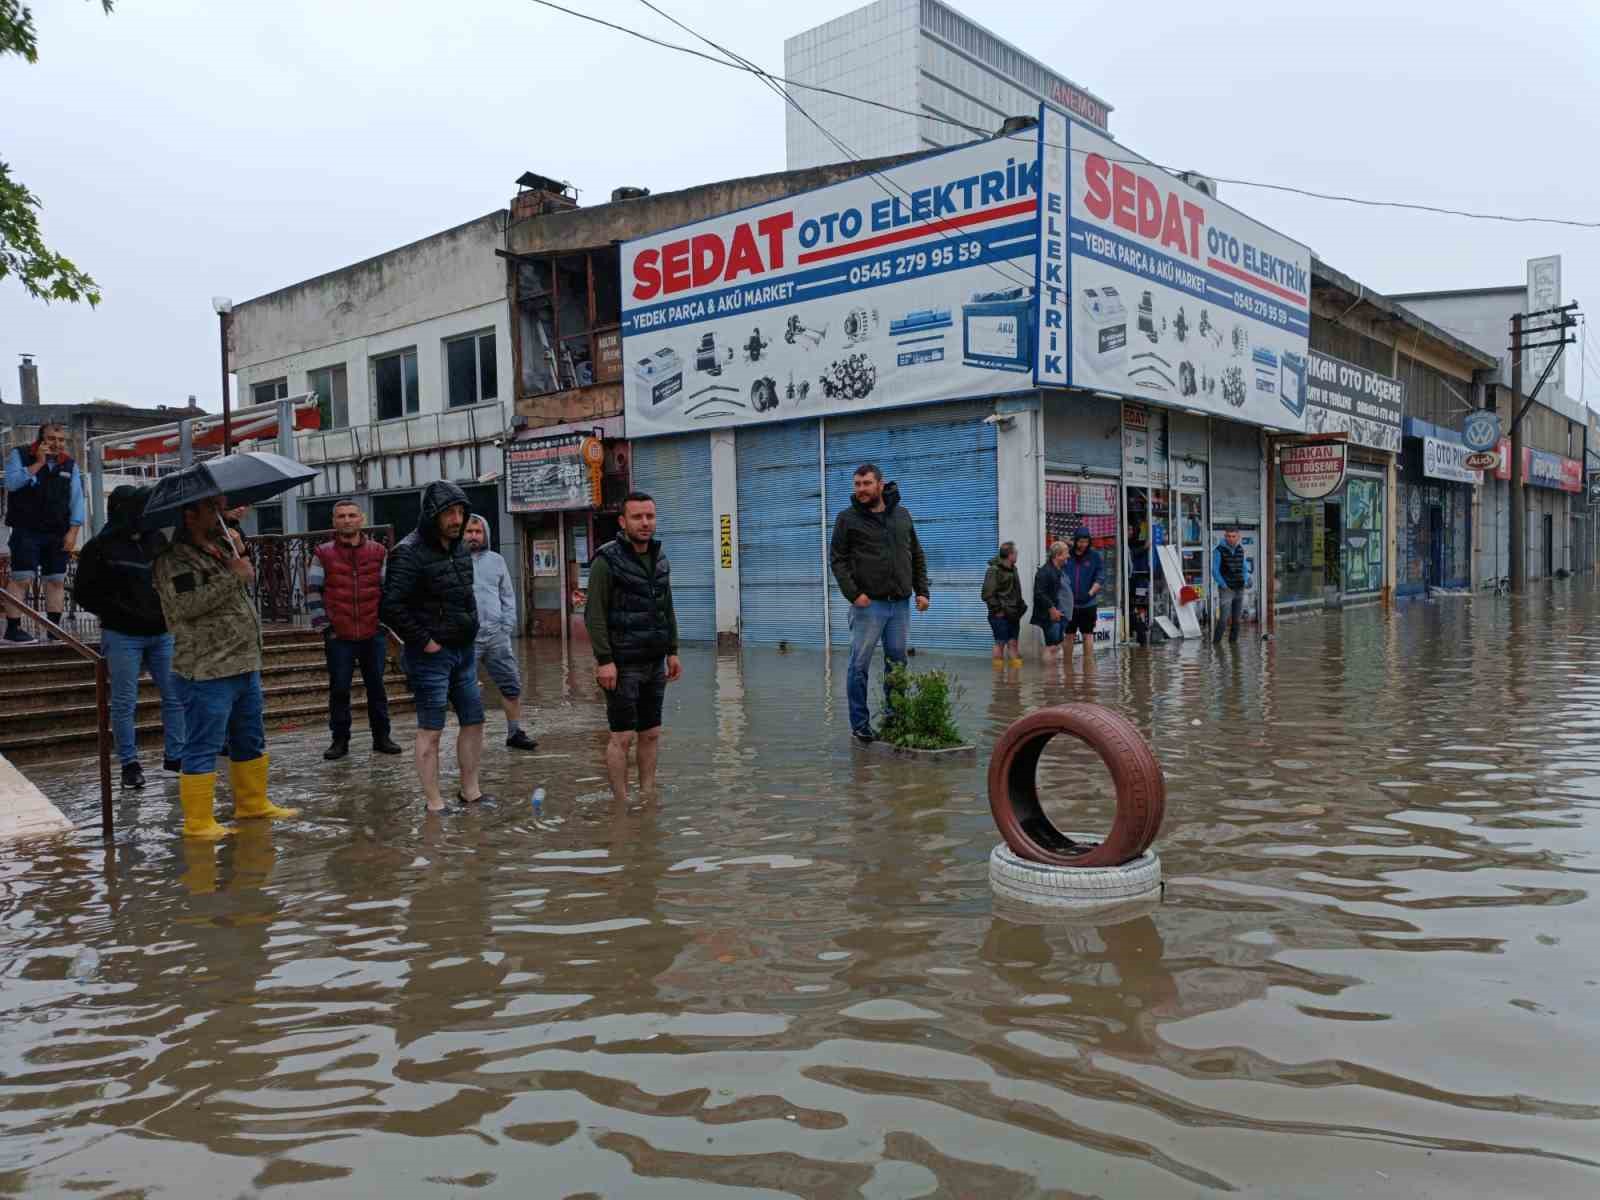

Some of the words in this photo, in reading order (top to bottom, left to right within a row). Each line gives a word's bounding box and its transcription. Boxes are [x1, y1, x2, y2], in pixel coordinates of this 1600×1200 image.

[632, 211, 794, 301] SEDAT
[798, 207, 863, 250] OTO
[871, 158, 1040, 232] ELEKTRİK
[1083, 152, 1205, 260] SEDAT
[1207, 226, 1239, 265] OTO
[1243, 243, 1307, 294] ELEKTRİK
[849, 259, 892, 285] 0545
[895, 254, 926, 276] 279
[931, 248, 954, 268] 95
[958, 241, 981, 262] 59
[1044, 191, 1062, 375] ELEKTRİK
[1084, 231, 1118, 260] YEDEK
[1118, 244, 1149, 273] PARÇA
[1149, 257, 1156, 274] &
[1156, 260, 1174, 281] AKÜ
[1174, 267, 1207, 295] MARKET
[633, 309, 669, 330] YEDEK
[668, 302, 706, 323] PARÇA
[707, 298, 715, 314] &
[717, 287, 743, 313] AKÜ
[744, 281, 795, 306] MARKET
[1340, 366, 1362, 391] OTO
[1365, 373, 1401, 404] DÖŞEME
[1289, 446, 1333, 459] HAKAN
[1436, 443, 1451, 465] OTO
